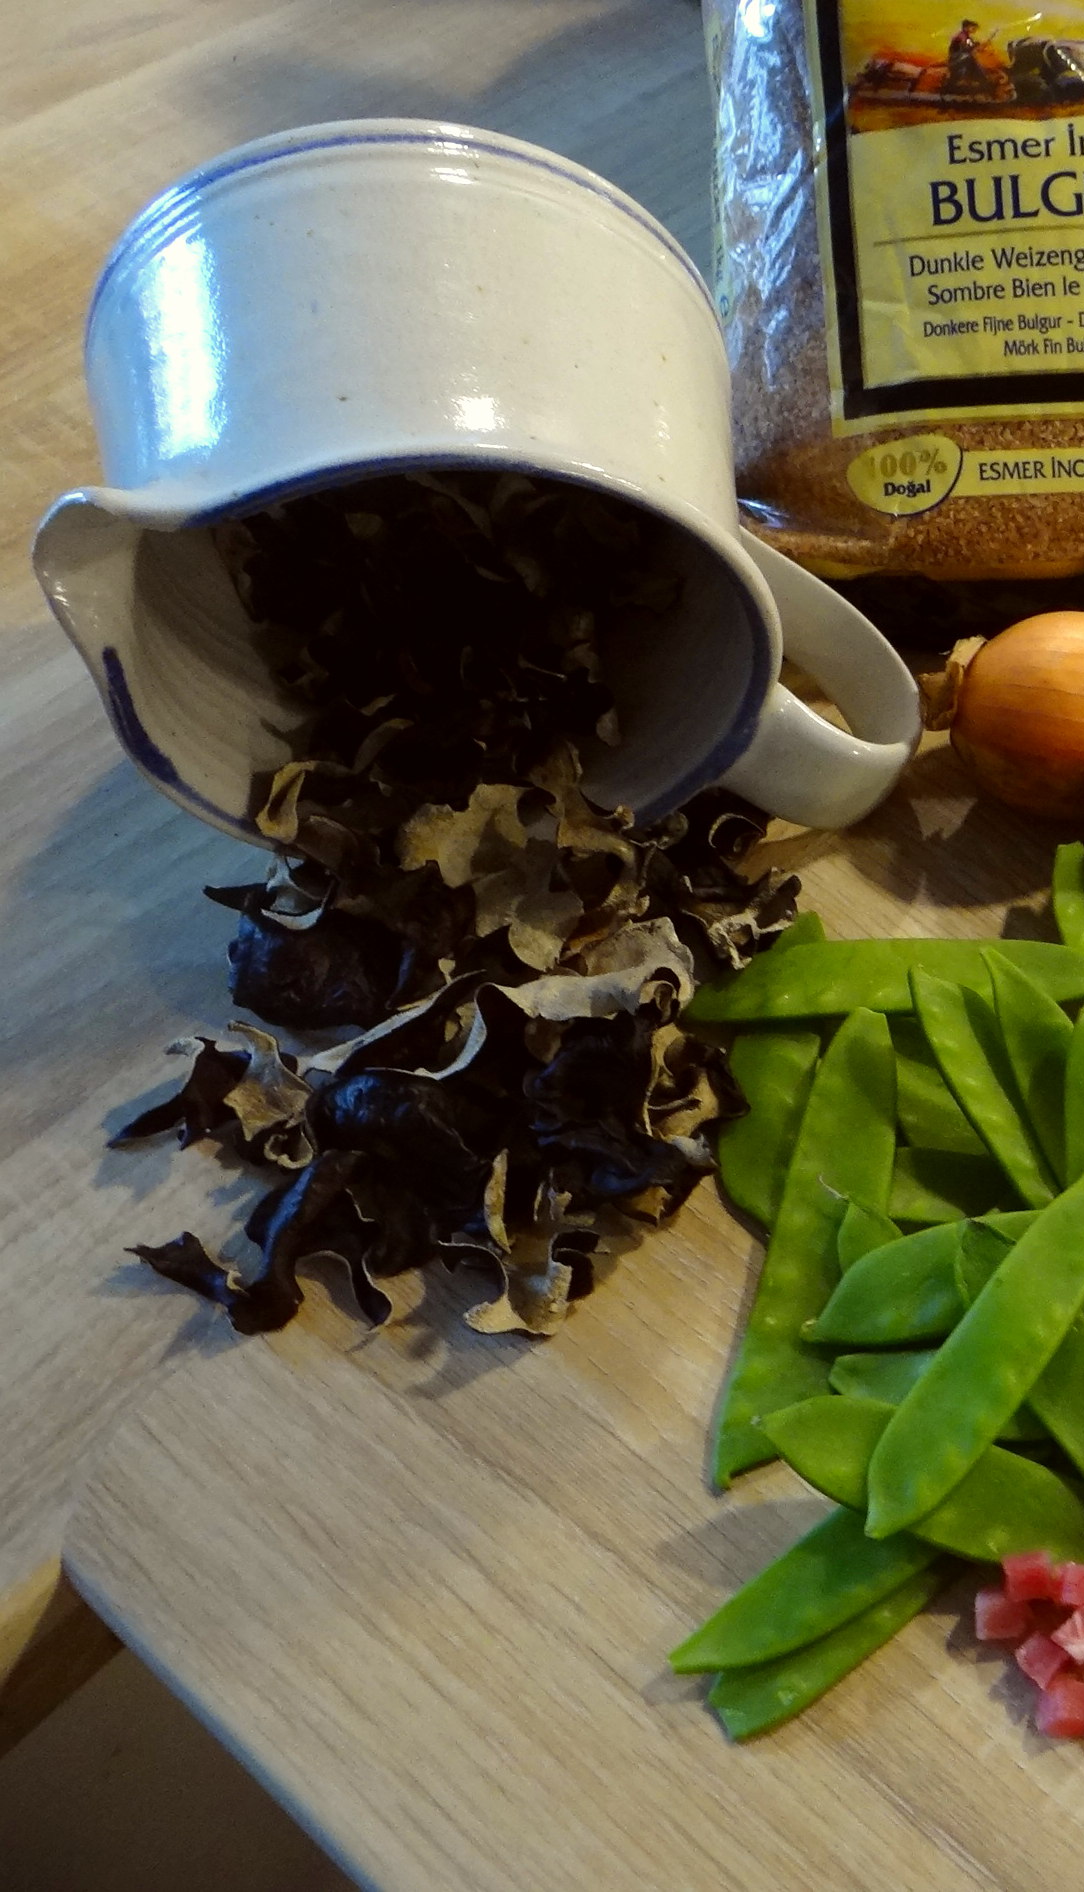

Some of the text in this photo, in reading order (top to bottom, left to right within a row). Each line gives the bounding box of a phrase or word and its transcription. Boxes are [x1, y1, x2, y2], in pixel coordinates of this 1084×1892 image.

[947, 134, 1055, 164] Esmer
[909, 251, 984, 277] Dunkle
[927, 280, 1005, 305] Sombre
[1012, 277, 1056, 298] Bien
[1063, 276, 1081, 296] le
[923, 319, 979, 337] Donkere
[983, 316, 1012, 334] Fijne
[1018, 313, 1062, 334] Bulgur
[1003, 341, 1039, 357] Mörk
[1043, 339, 1063, 354] Fin
[866, 448, 947, 479] 100%
[979, 459, 1046, 481] ESMER
[883, 479, 932, 498] Doğal
